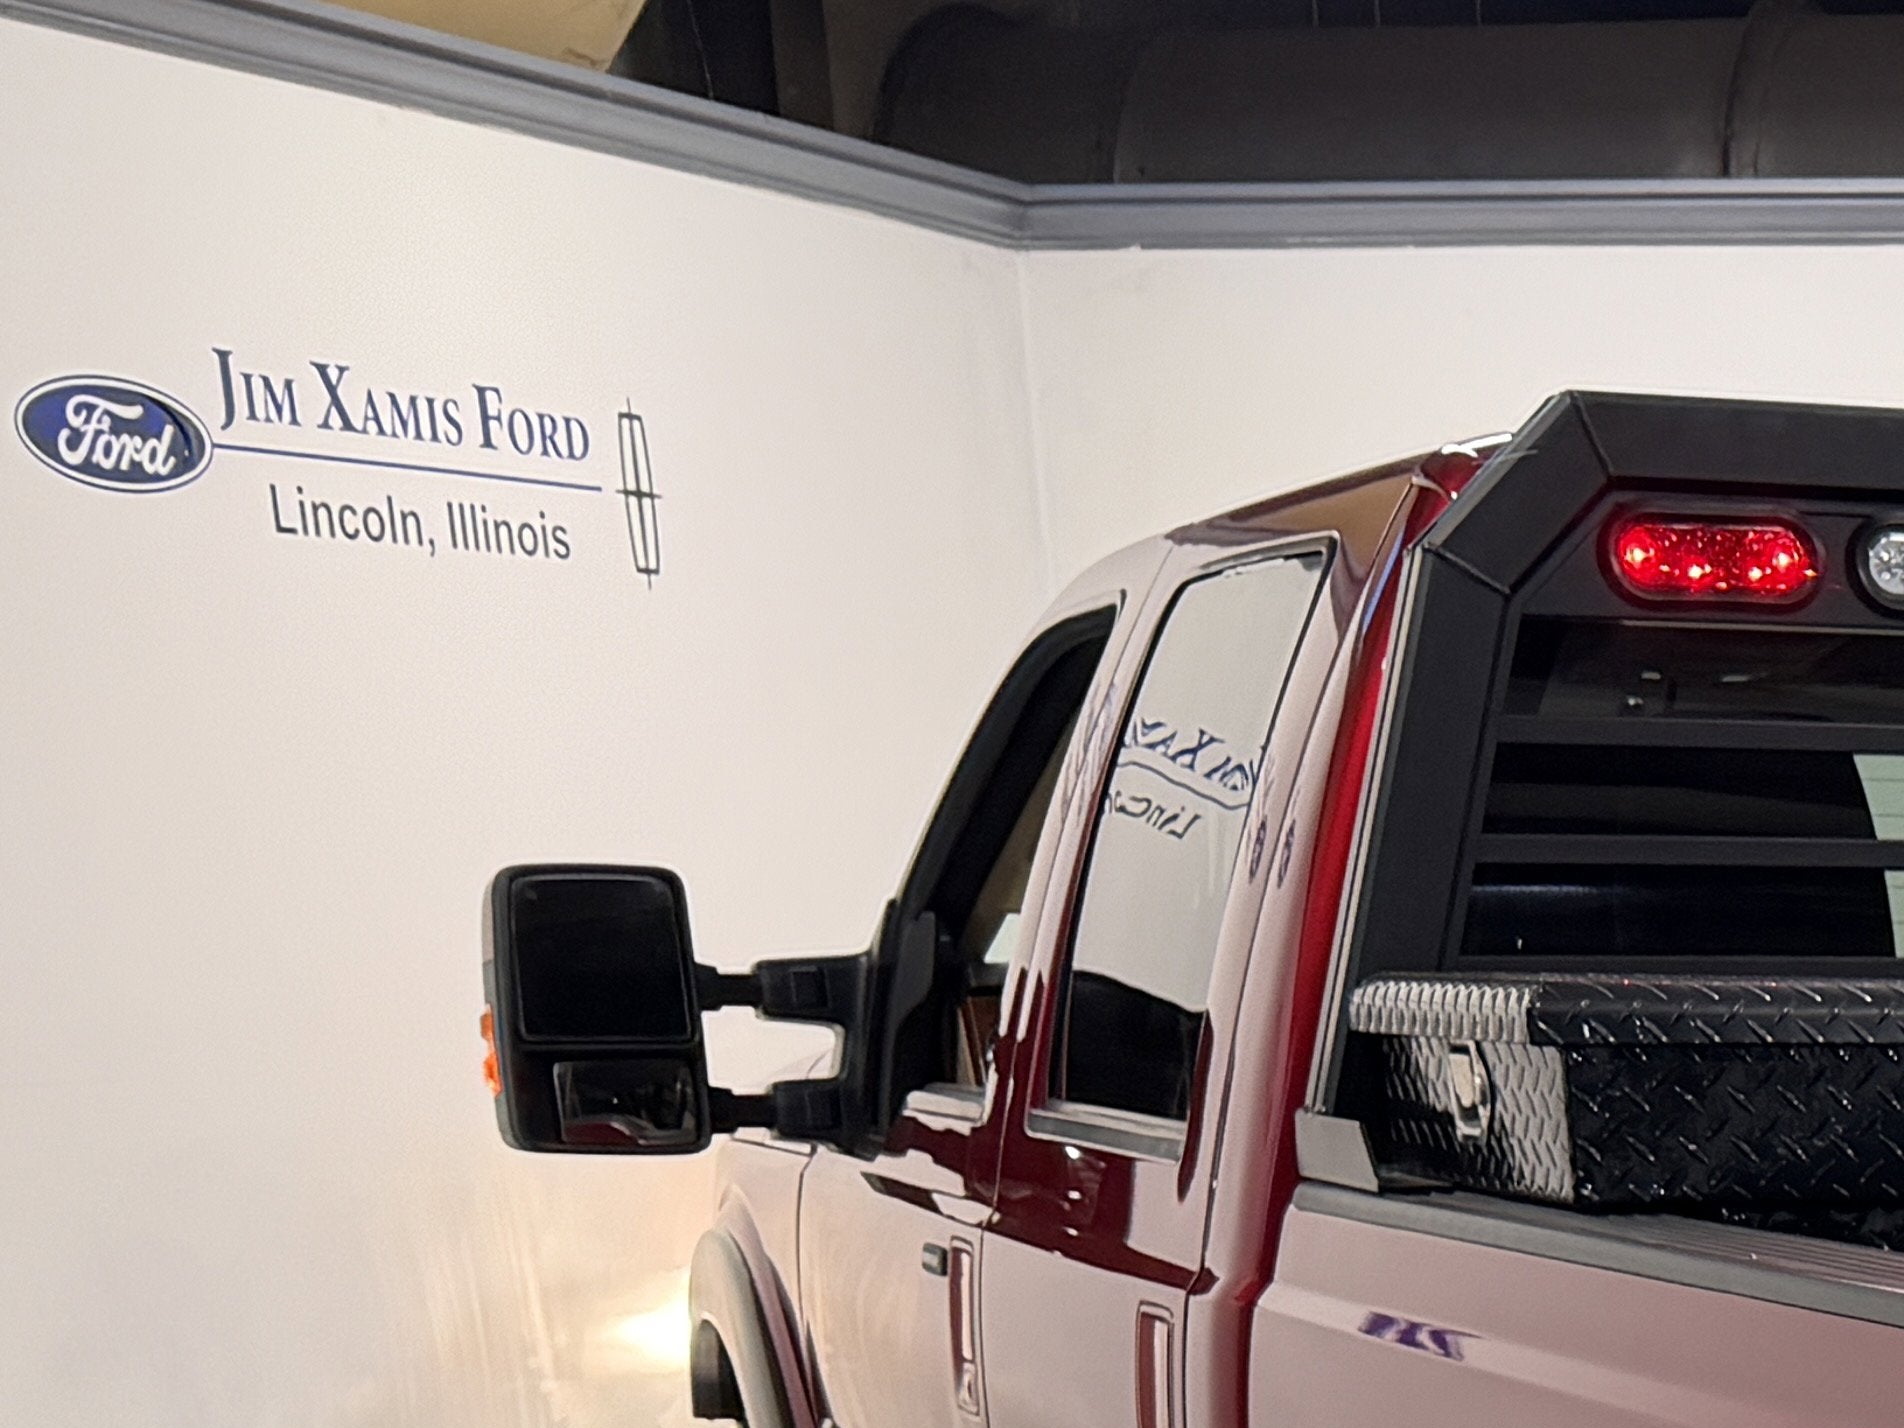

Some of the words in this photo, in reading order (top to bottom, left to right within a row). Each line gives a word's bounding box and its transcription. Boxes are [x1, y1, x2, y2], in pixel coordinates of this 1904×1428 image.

[57, 394, 176, 477] Ford
[210, 347, 302, 430] JIM
[309, 360, 465, 448] XAMIS
[471, 383, 591, 462] FORD
[268, 482, 437, 556] Lincoln,
[446, 500, 572, 560] Illinois
